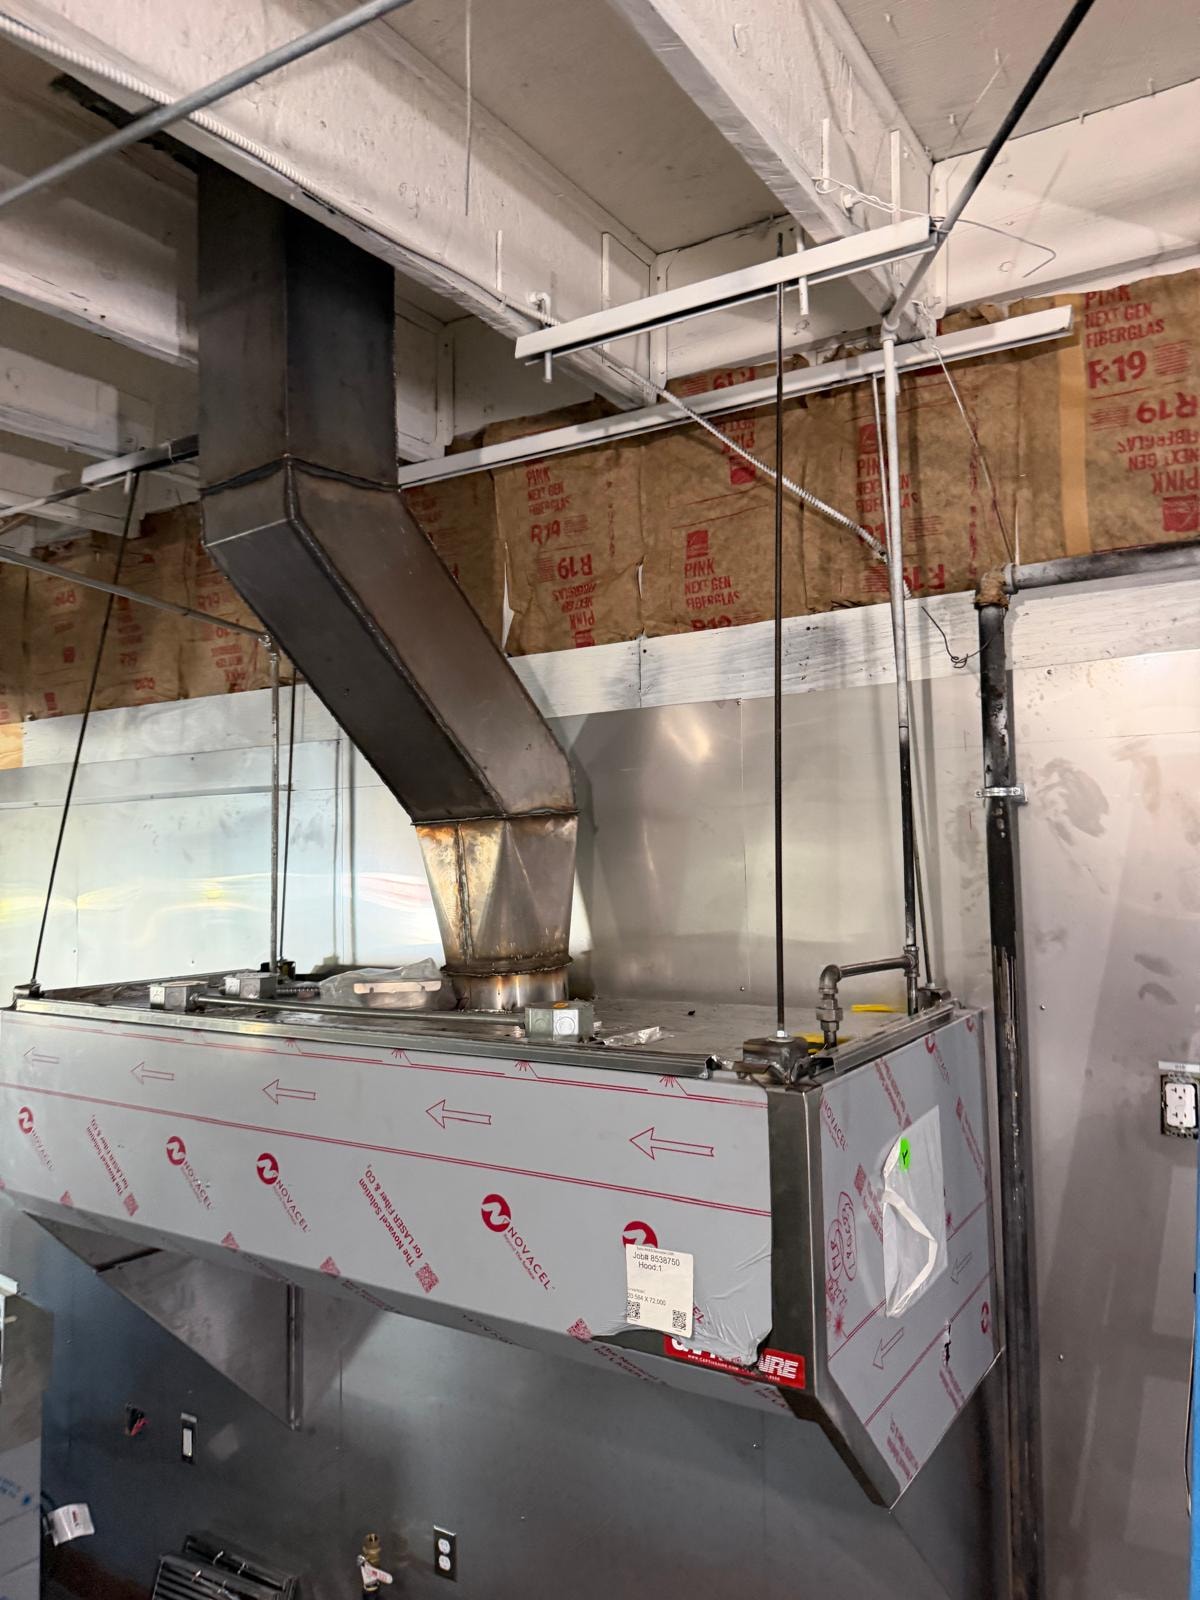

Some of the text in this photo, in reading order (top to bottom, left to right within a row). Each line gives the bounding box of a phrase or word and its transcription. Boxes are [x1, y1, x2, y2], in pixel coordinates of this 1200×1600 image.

[1124, 302, 1152, 321] GEN
[1086, 319, 1164, 349] FIBERGLAS
[1128, 452, 1157, 472] GEN
[1152, 469, 1200, 494] PINK
[684, 558, 715, 579] PINK
[711, 575, 732, 591] GEN
[276, 1179, 309, 1232] NOVACEL
[378, 1190, 397, 1215] Fiber
[357, 1178, 416, 1267] The Novacel Solution
[393, 1214, 415, 1245] LASER
[411, 1243, 424, 1259] for
[506, 1225, 551, 1290] NOVACEL
[632, 1251, 649, 1260] Job#
[650, 1254, 680, 1267] 8538750
